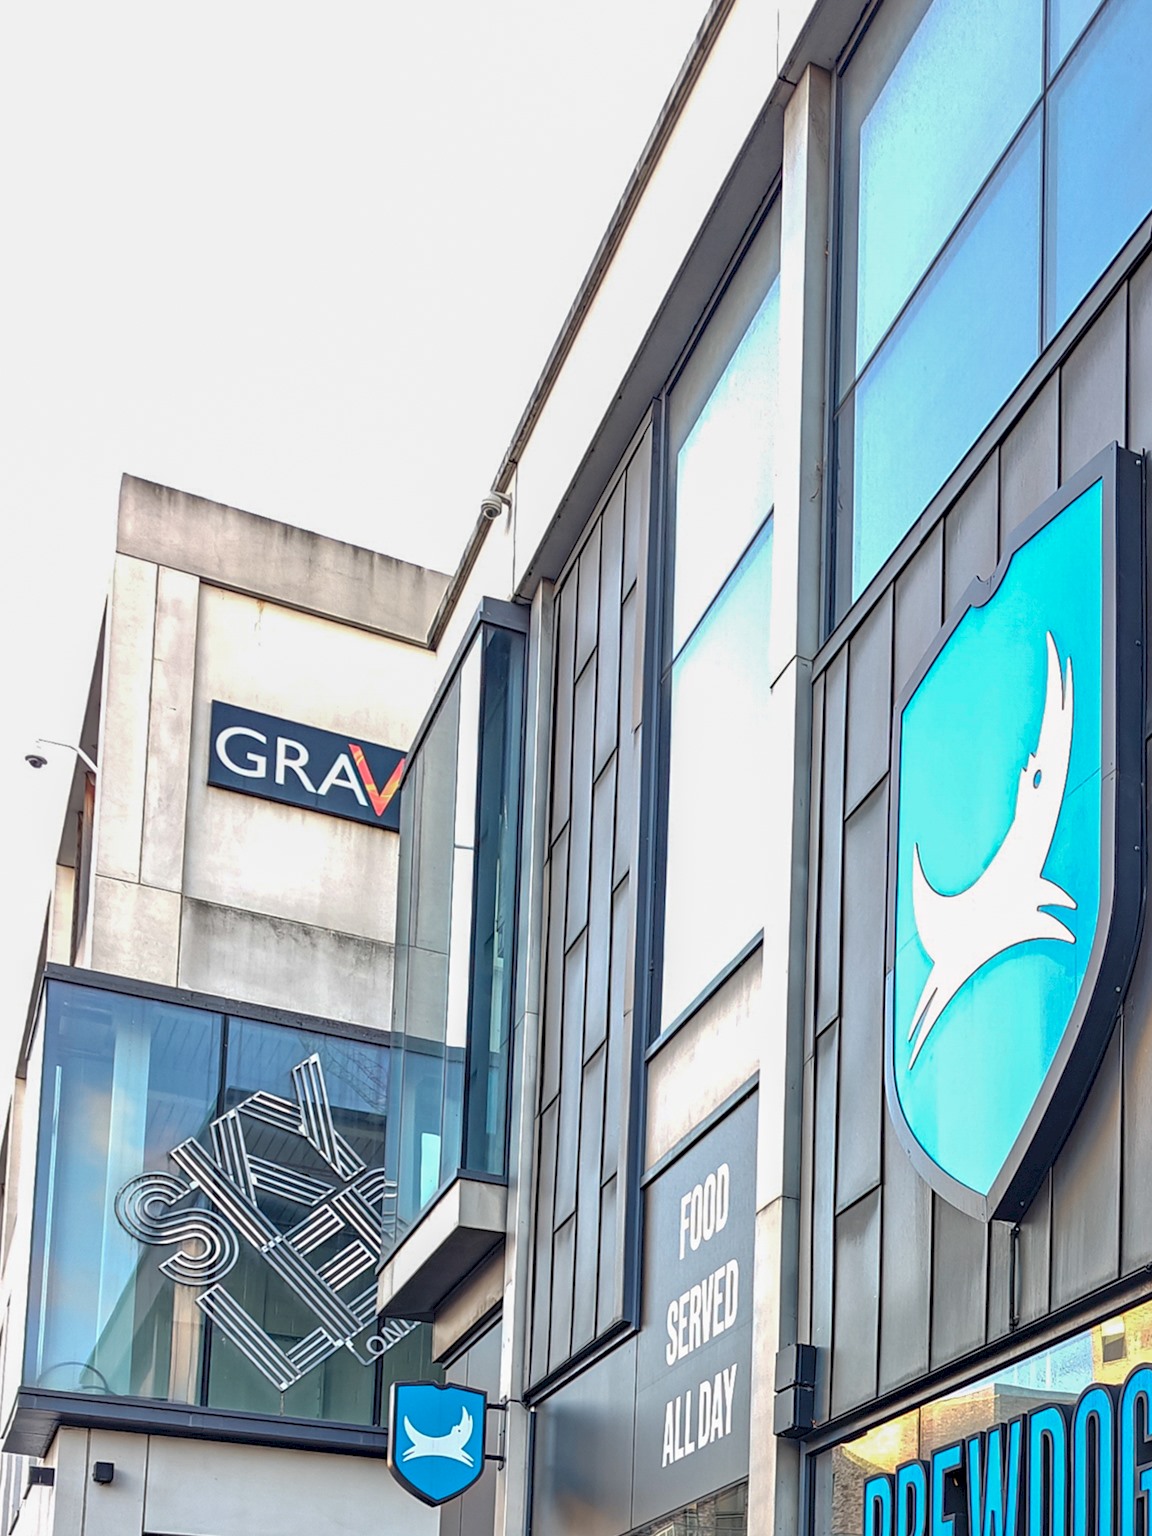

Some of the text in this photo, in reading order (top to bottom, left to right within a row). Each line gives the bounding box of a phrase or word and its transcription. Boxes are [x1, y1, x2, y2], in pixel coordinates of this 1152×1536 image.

[679, 1162, 730, 1261] FOOD
[665, 1258, 740, 1367] SERVED
[661, 1362, 738, 1469] ALL DAY
